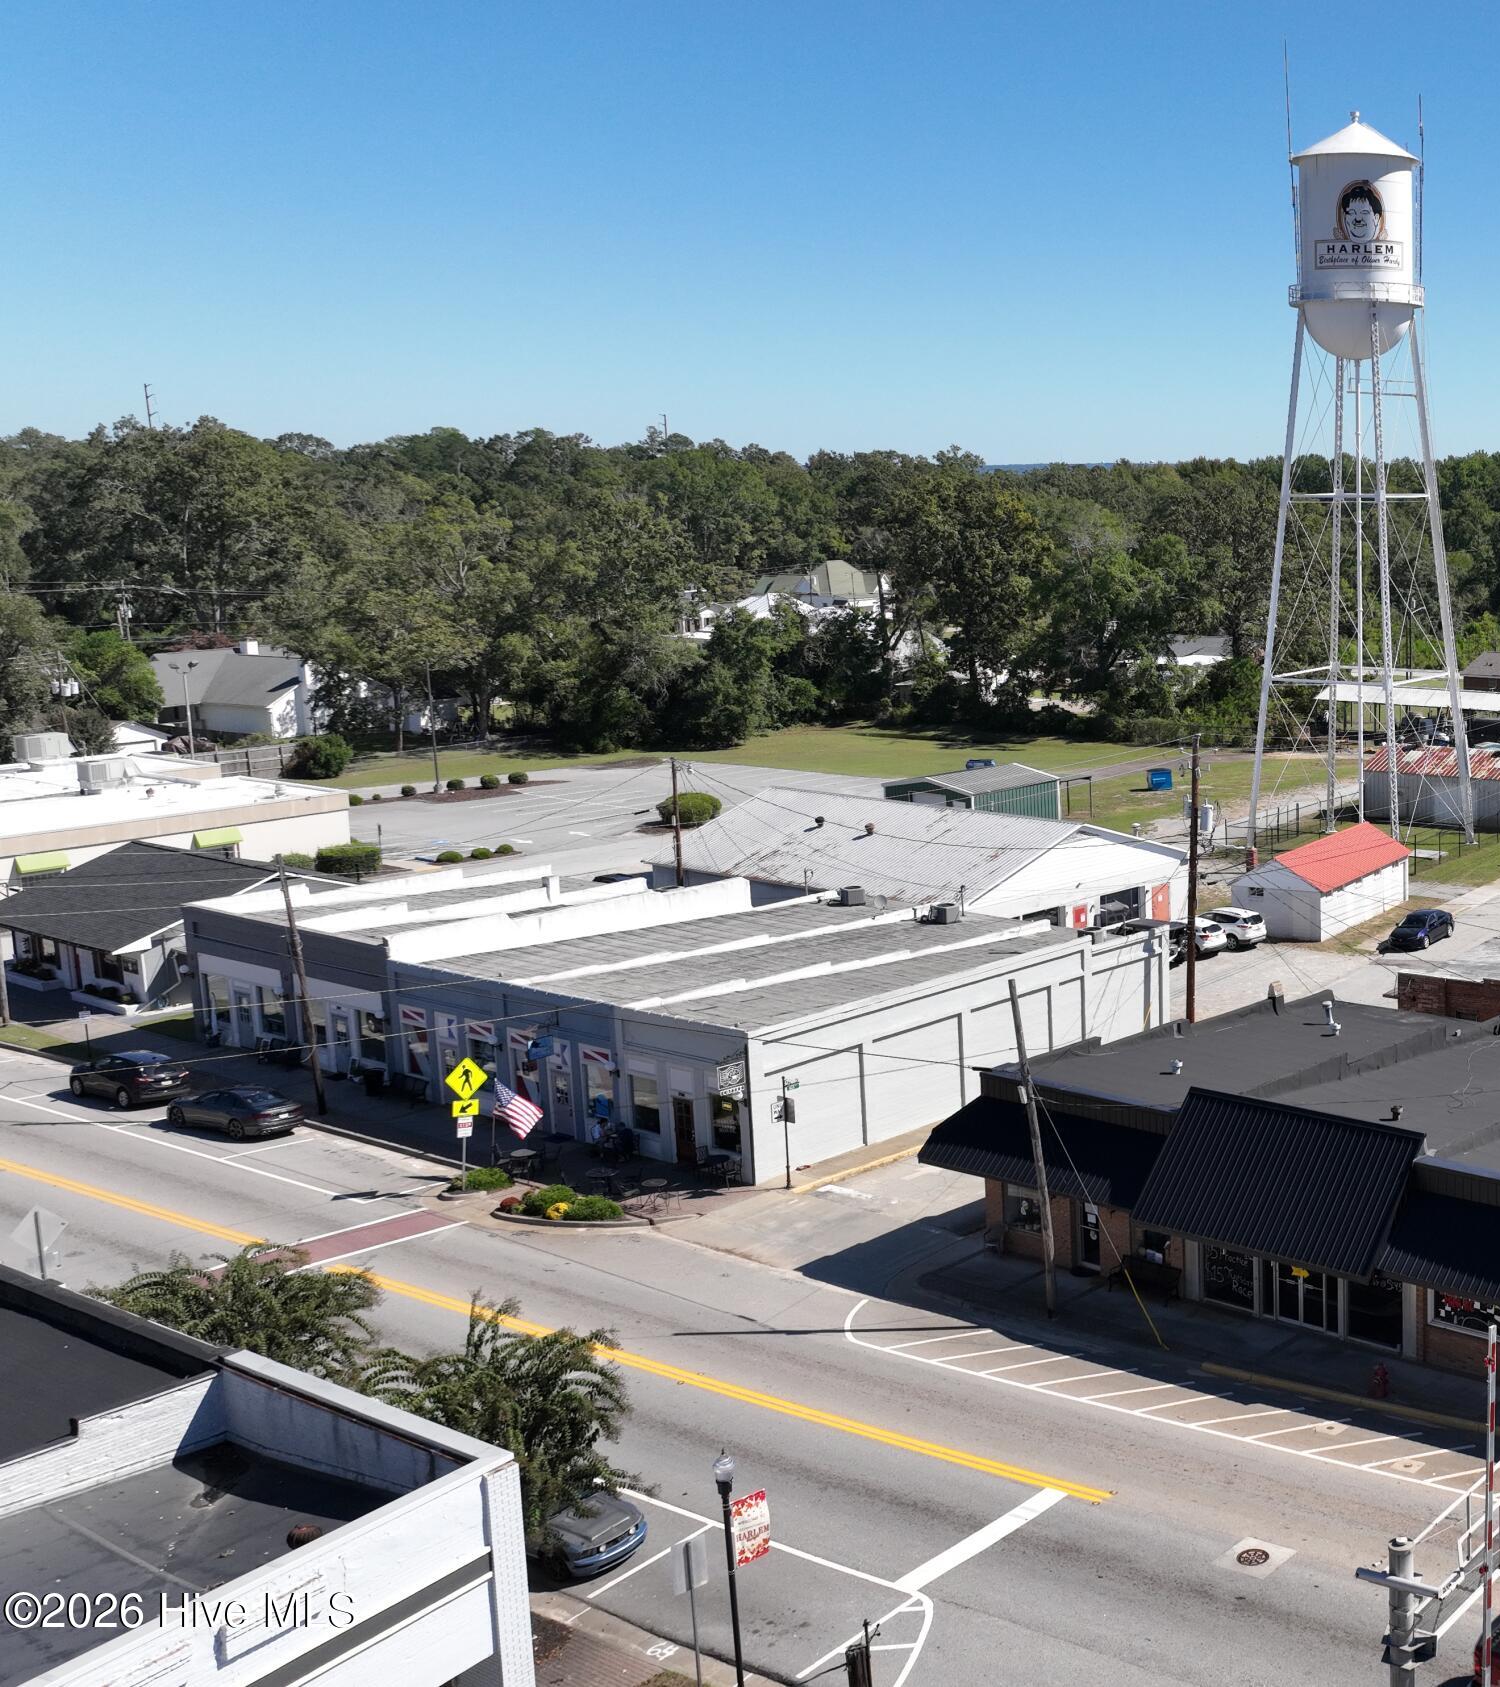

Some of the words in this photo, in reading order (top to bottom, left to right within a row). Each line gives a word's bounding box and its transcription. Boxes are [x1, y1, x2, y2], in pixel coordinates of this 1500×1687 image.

[1327, 244, 1394, 255] HARLEM
[1319, 255, 1348, 265] Birthplace
[1361, 255, 1380, 264] Oliver
[1384, 255, 1400, 266] Hardy
[736, 1524, 769, 1542] HARLEM
